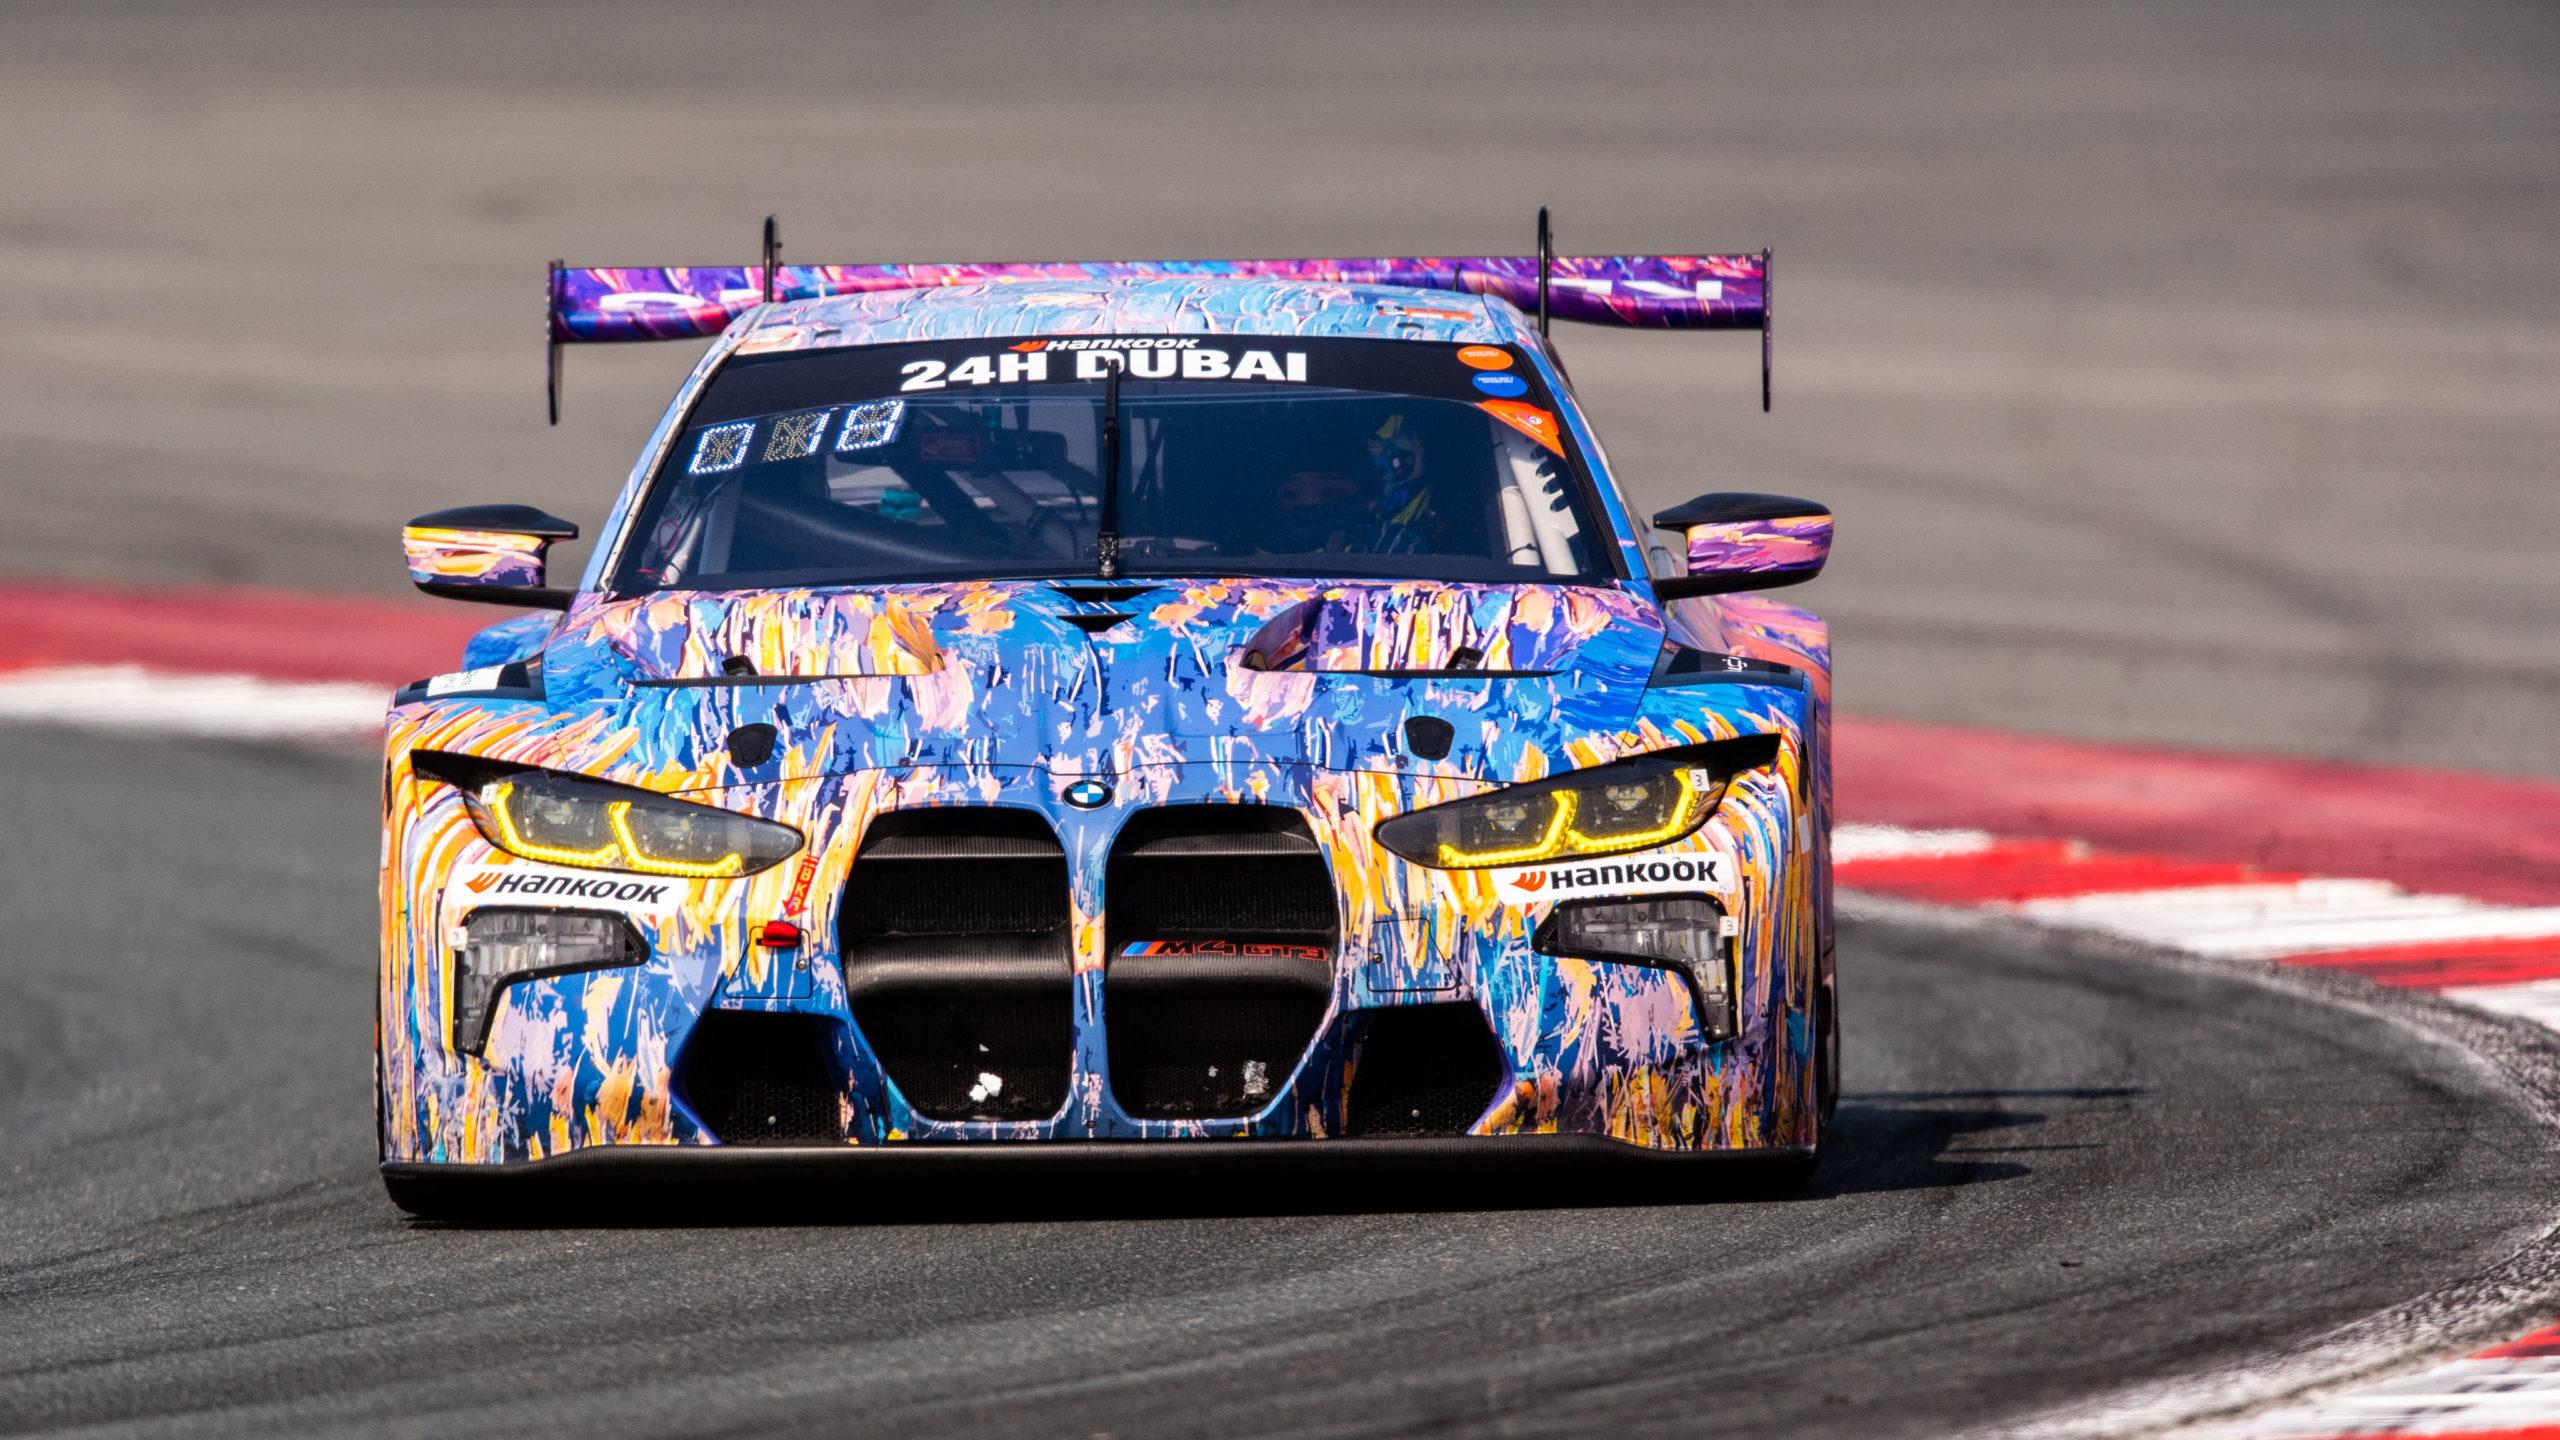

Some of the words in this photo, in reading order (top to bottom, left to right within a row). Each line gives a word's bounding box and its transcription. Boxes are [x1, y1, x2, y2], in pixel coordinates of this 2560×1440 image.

[900, 354, 1048, 392] 24H
[1075, 349, 1308, 382] DUBAI
[1243, 943, 1327, 962] GT3
